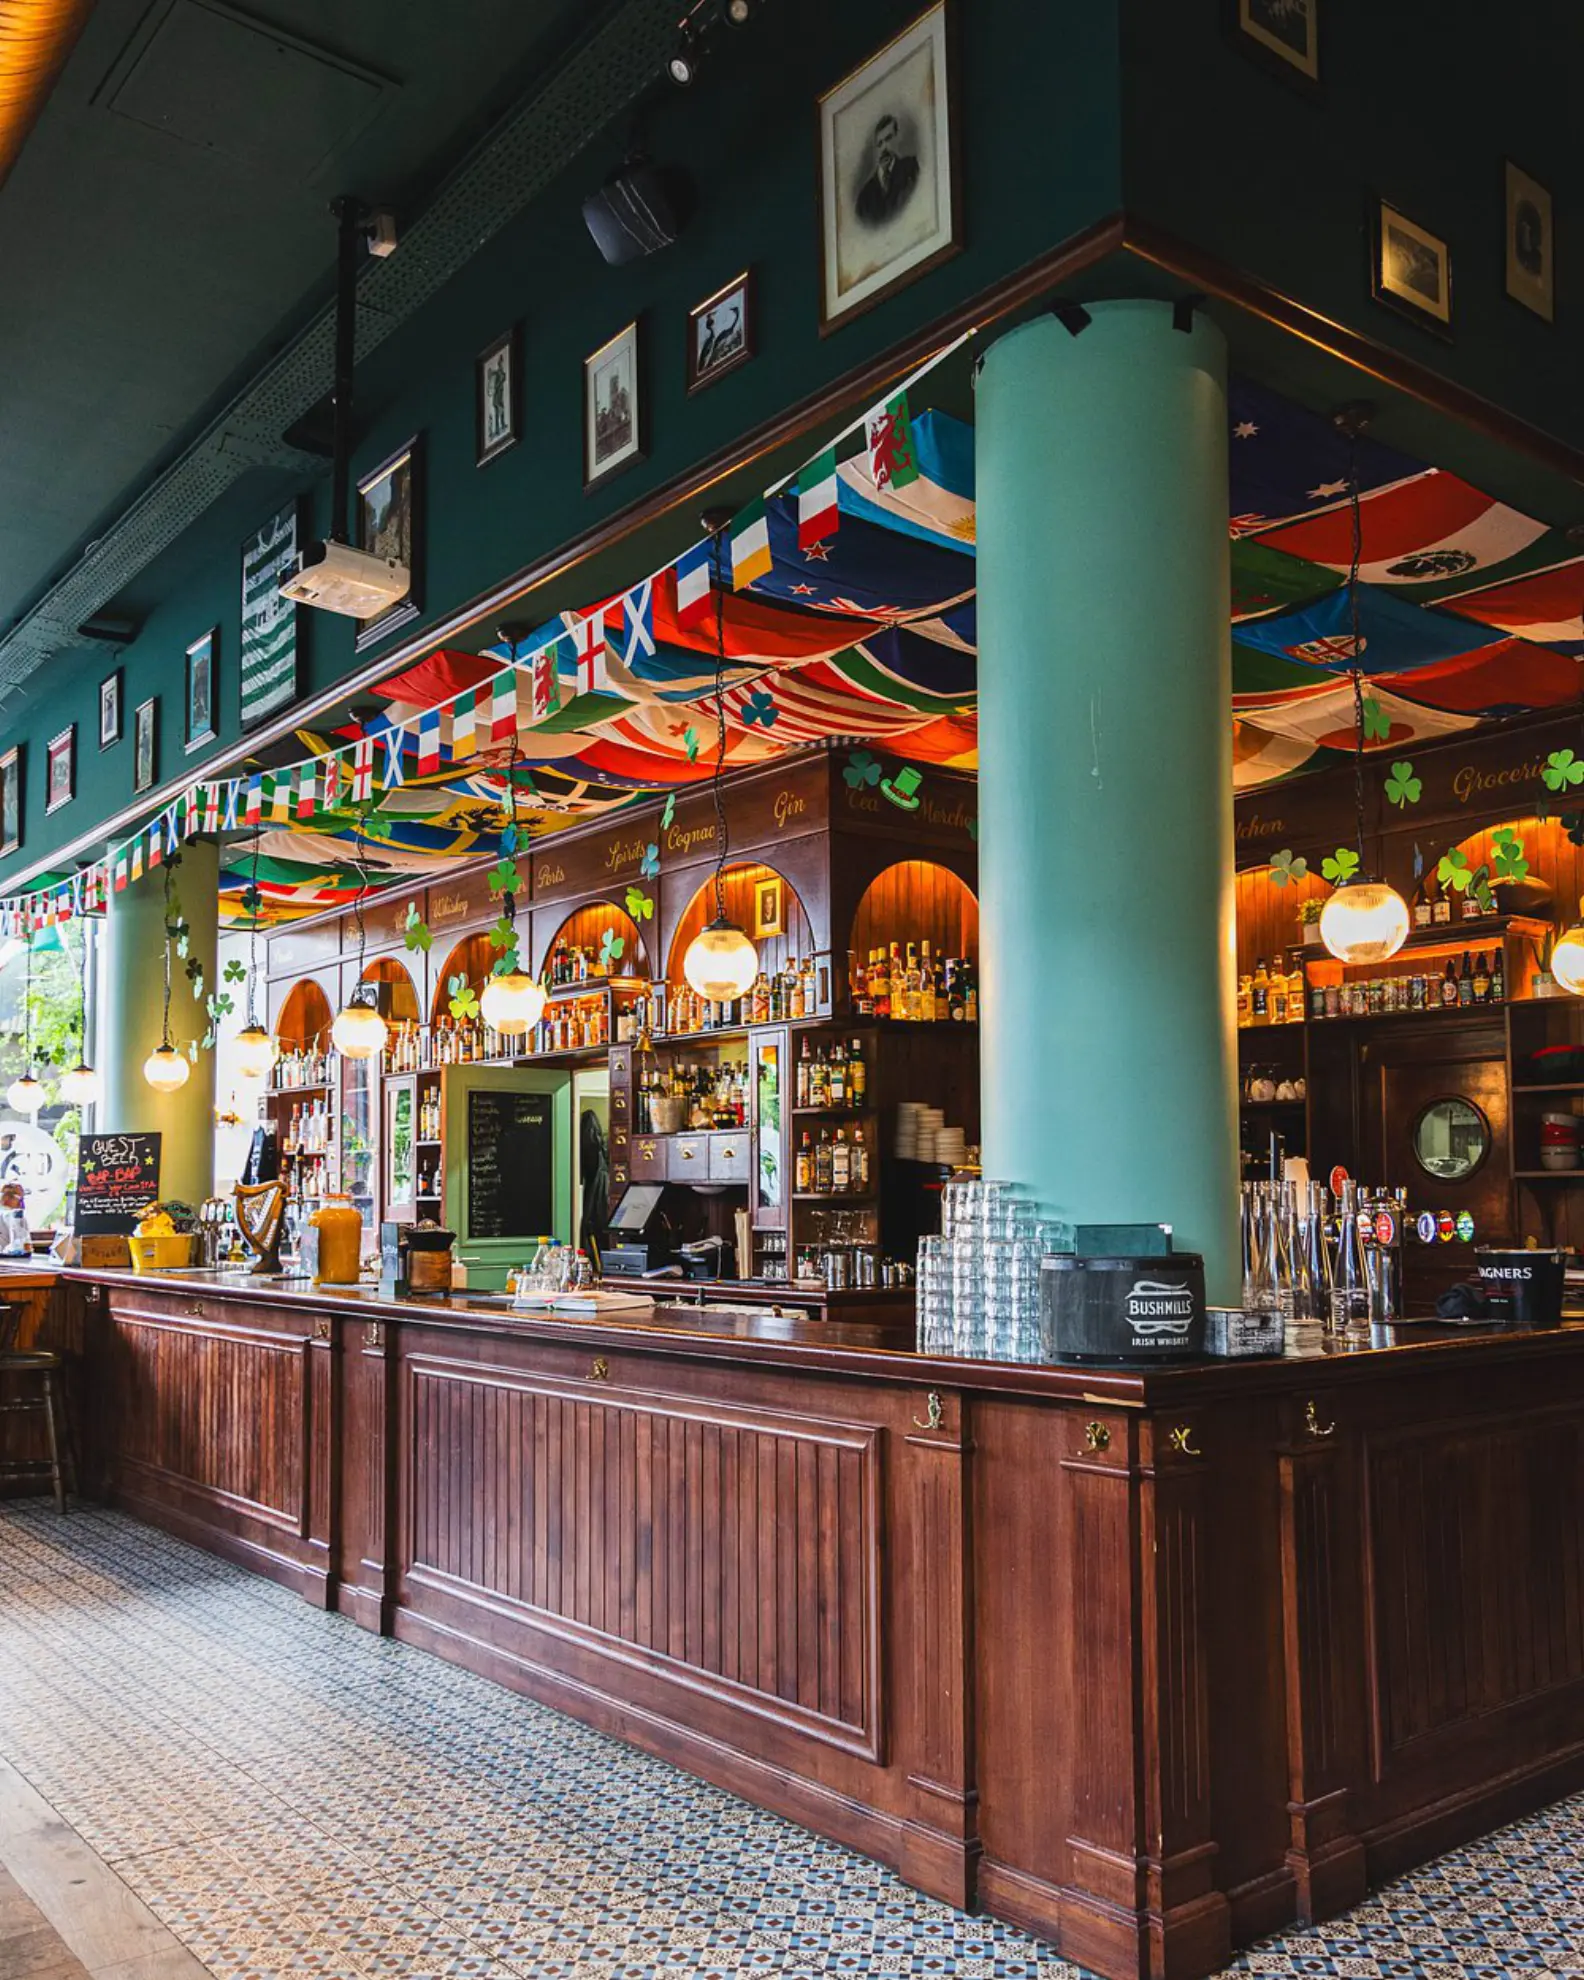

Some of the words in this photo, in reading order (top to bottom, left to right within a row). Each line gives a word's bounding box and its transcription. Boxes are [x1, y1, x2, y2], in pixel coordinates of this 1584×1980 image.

[1453, 758, 1549, 803] Grocerie
[773, 791, 806, 827] Gin
[912, 797, 973, 828] Mercha
[667, 824, 716, 852] Cognac
[1234, 814, 1286, 840] tchen
[605, 840, 646, 872] Spirits
[537, 864, 565, 889] Ports
[92, 1136, 147, 1156] GUEST
[100, 1152, 139, 1167] BEER
[1129, 1299, 1192, 1316] BUSHMILLS
[1131, 1337, 1156, 1346] IRISH
